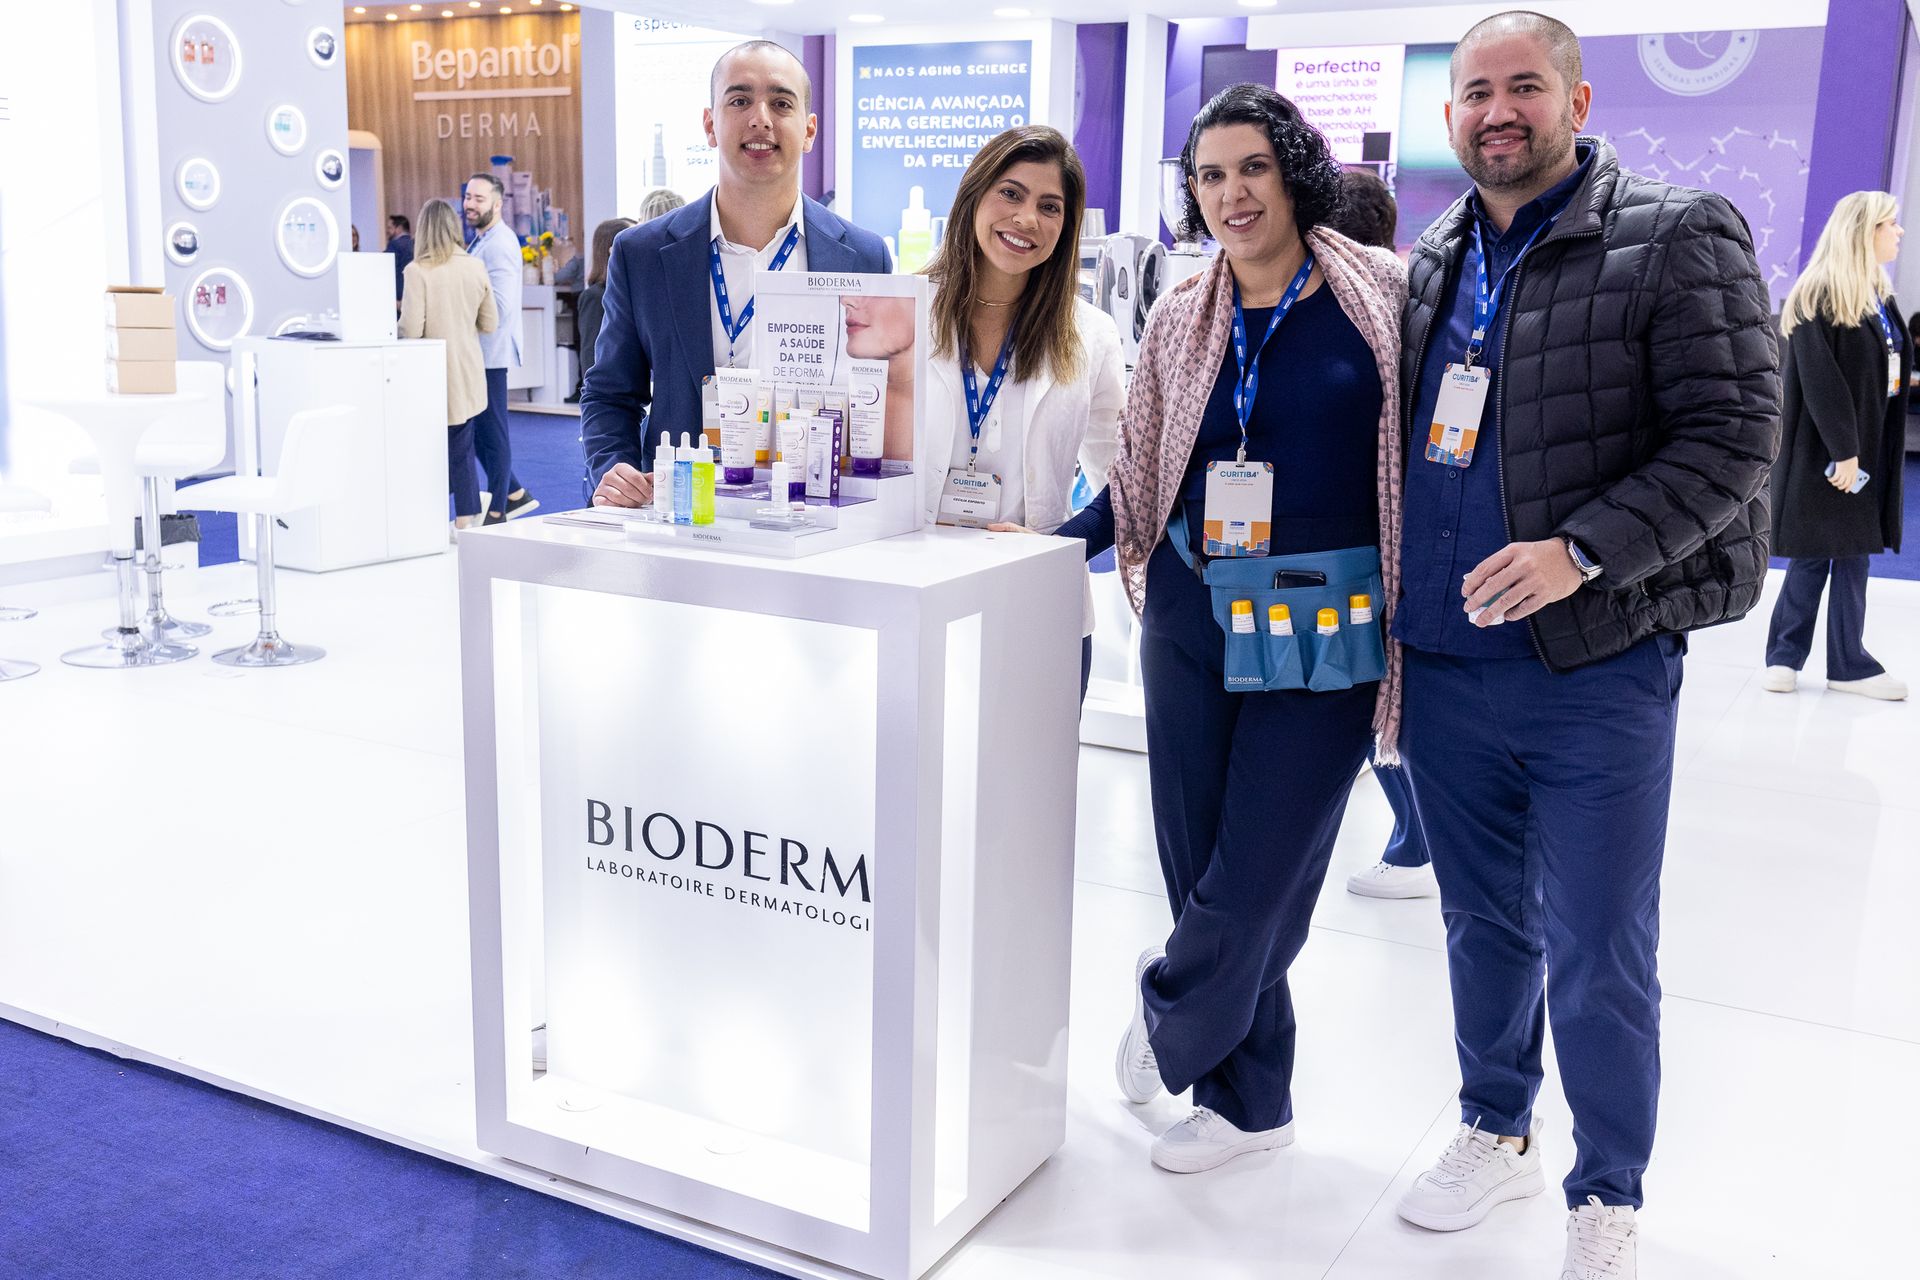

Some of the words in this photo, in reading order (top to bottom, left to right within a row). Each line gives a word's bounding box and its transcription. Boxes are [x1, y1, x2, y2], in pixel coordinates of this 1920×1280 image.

[873, 66, 915, 77] NAOS
[919, 65, 962, 76] AGING
[967, 63, 1028, 76] SCIENCE
[1294, 60, 1381, 74] Perfectha
[1306, 80, 1330, 88] uma
[1333, 78, 1359, 87] linha
[1362, 77, 1377, 87] de
[858, 95, 926, 112] CIÊNCIA
[931, 95, 1025, 112] AVANÇADA
[1293, 93, 1378, 103] preenchedores
[1307, 107, 1334, 117] base
[1337, 106, 1351, 116] de
[437, 112, 542, 139] DERMA
[858, 116, 902, 130] PARA
[907, 115, 1005, 129] GERENCIAR
[1010, 114, 1024, 127] O
[1318, 120, 1377, 132] tecnologia
[862, 134, 997, 149] ENVELHECIMEN
[903, 155, 927, 167] DA
[932, 154, 973, 167] PELE
[807, 277, 862, 288] BIODERMA
[767, 323, 825, 335] EMPODERE
[780, 338, 788, 348] A
[790, 336, 825, 349] SAÚDE
[780, 352, 795, 363] DA
[773, 366, 787, 377] DE
[789, 367, 825, 378] FORMA
[851, 366, 883, 374] BIODERMA
[692, 533, 722, 542] BIODERMA
[586, 798, 872, 904] BIODERM
[586, 856, 715, 897] LABORATOIRE
[724, 886, 870, 932] DERMATOLOGI
